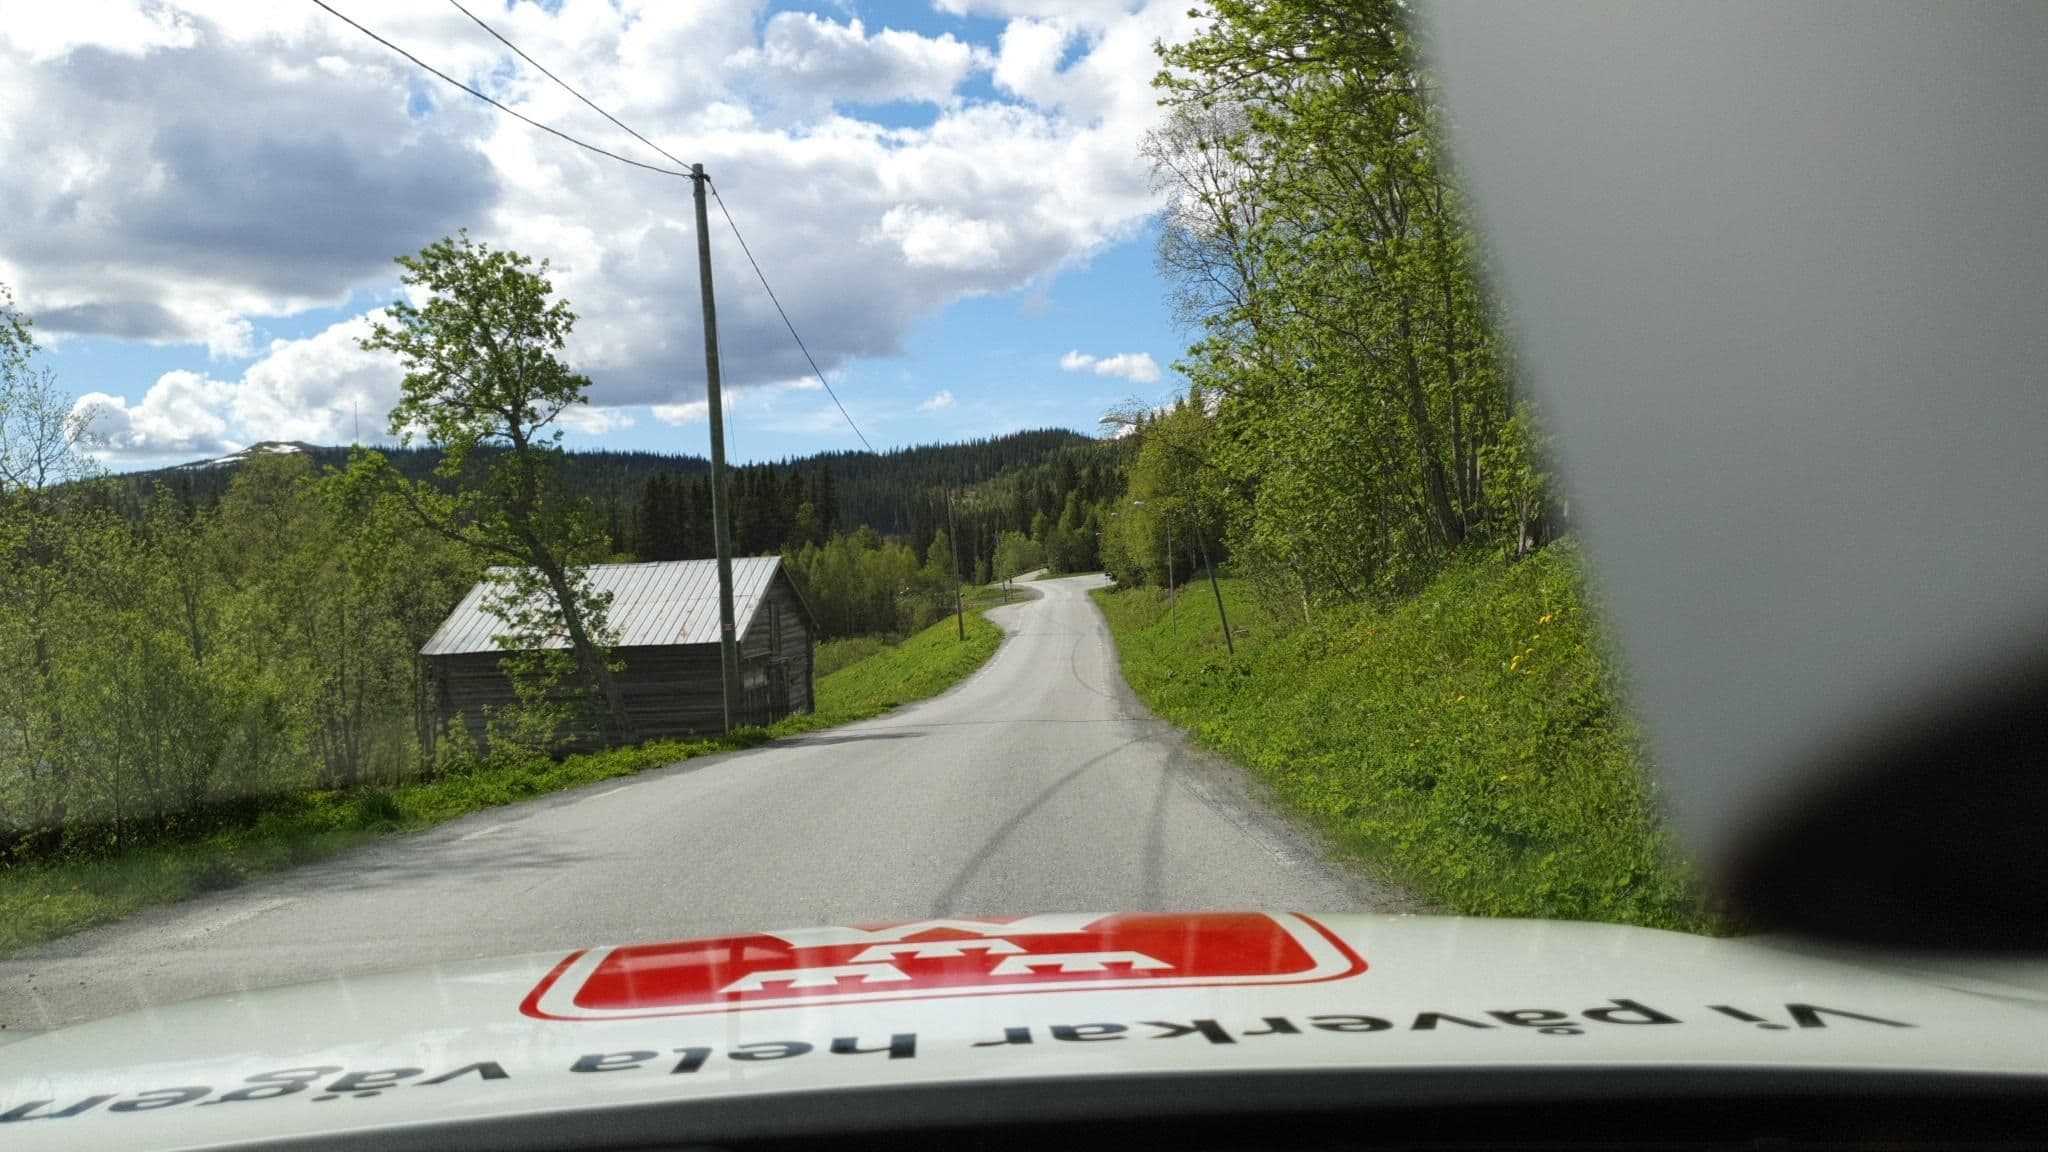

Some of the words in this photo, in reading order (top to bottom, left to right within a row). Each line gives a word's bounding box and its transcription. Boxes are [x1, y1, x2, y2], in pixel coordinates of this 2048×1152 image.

[970, 999, 1684, 1047] påverkar
[1704, 1003, 1921, 1030] Vi
[569, 1033, 917, 1075] hela
[0, 1061, 511, 1123] vägen
